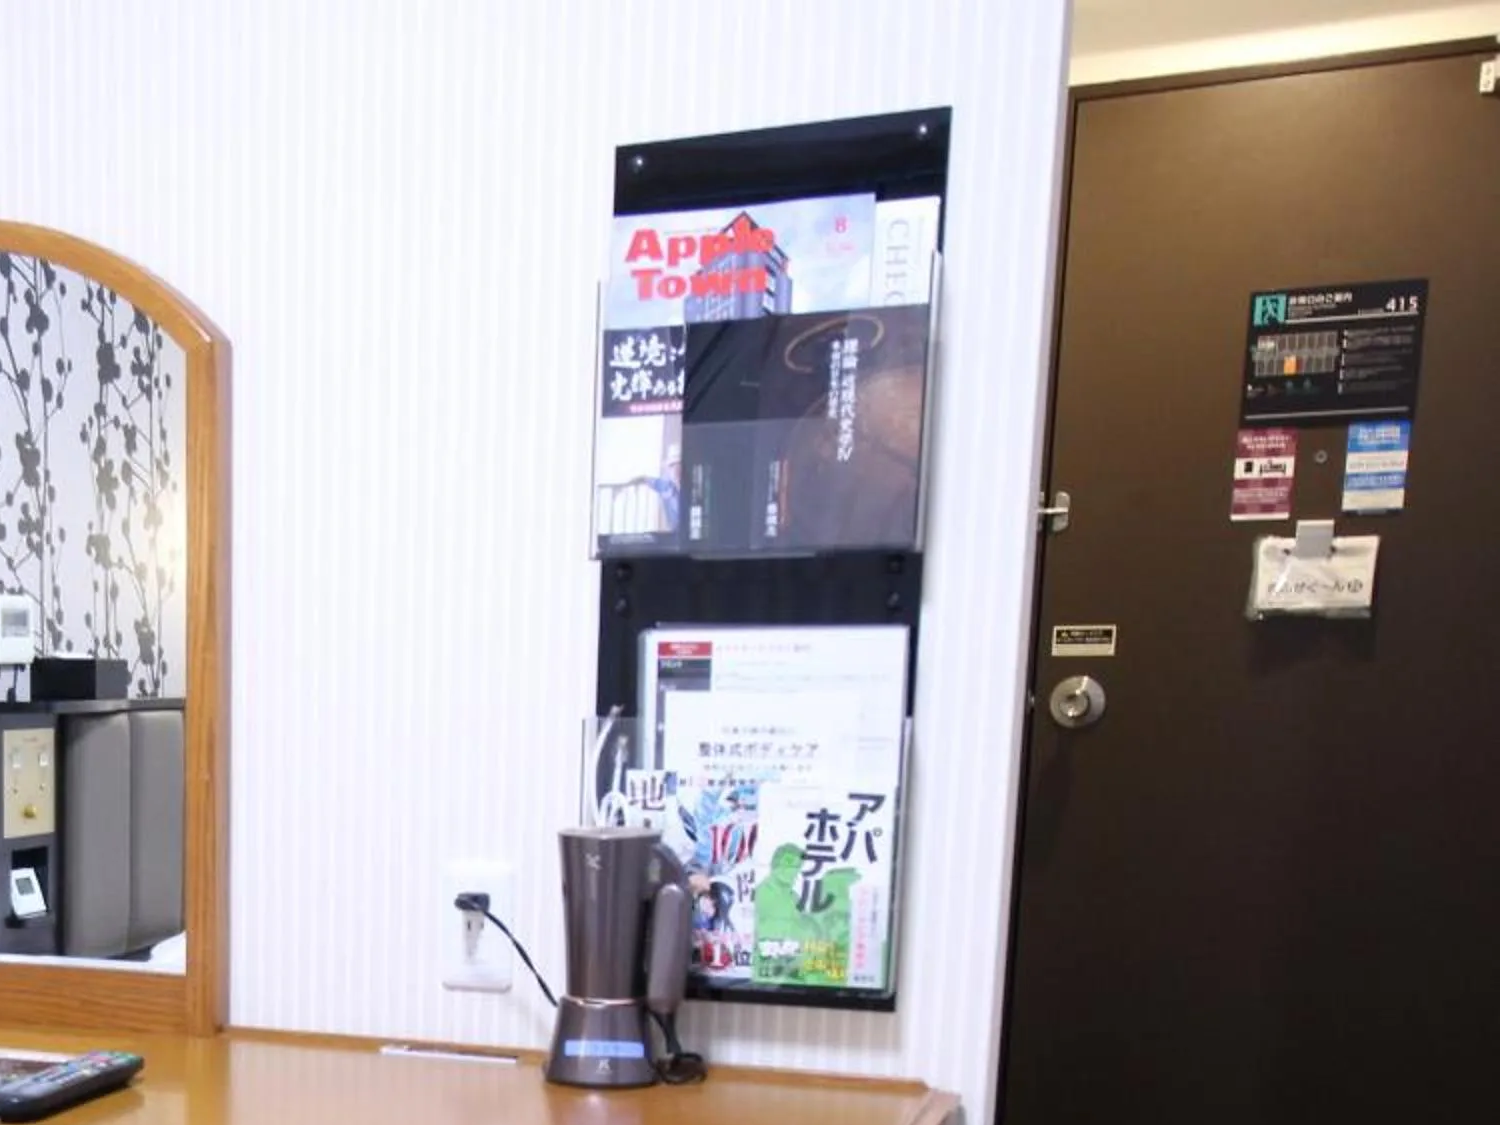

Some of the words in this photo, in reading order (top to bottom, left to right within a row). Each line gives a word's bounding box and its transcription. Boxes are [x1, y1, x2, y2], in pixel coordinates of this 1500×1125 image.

[626, 217, 774, 266] Apple
[631, 267, 767, 300] Town
[1385, 296, 1419, 313] 415
[840, 791, 886, 864] アパ
[796, 807, 841, 913] ホテル
